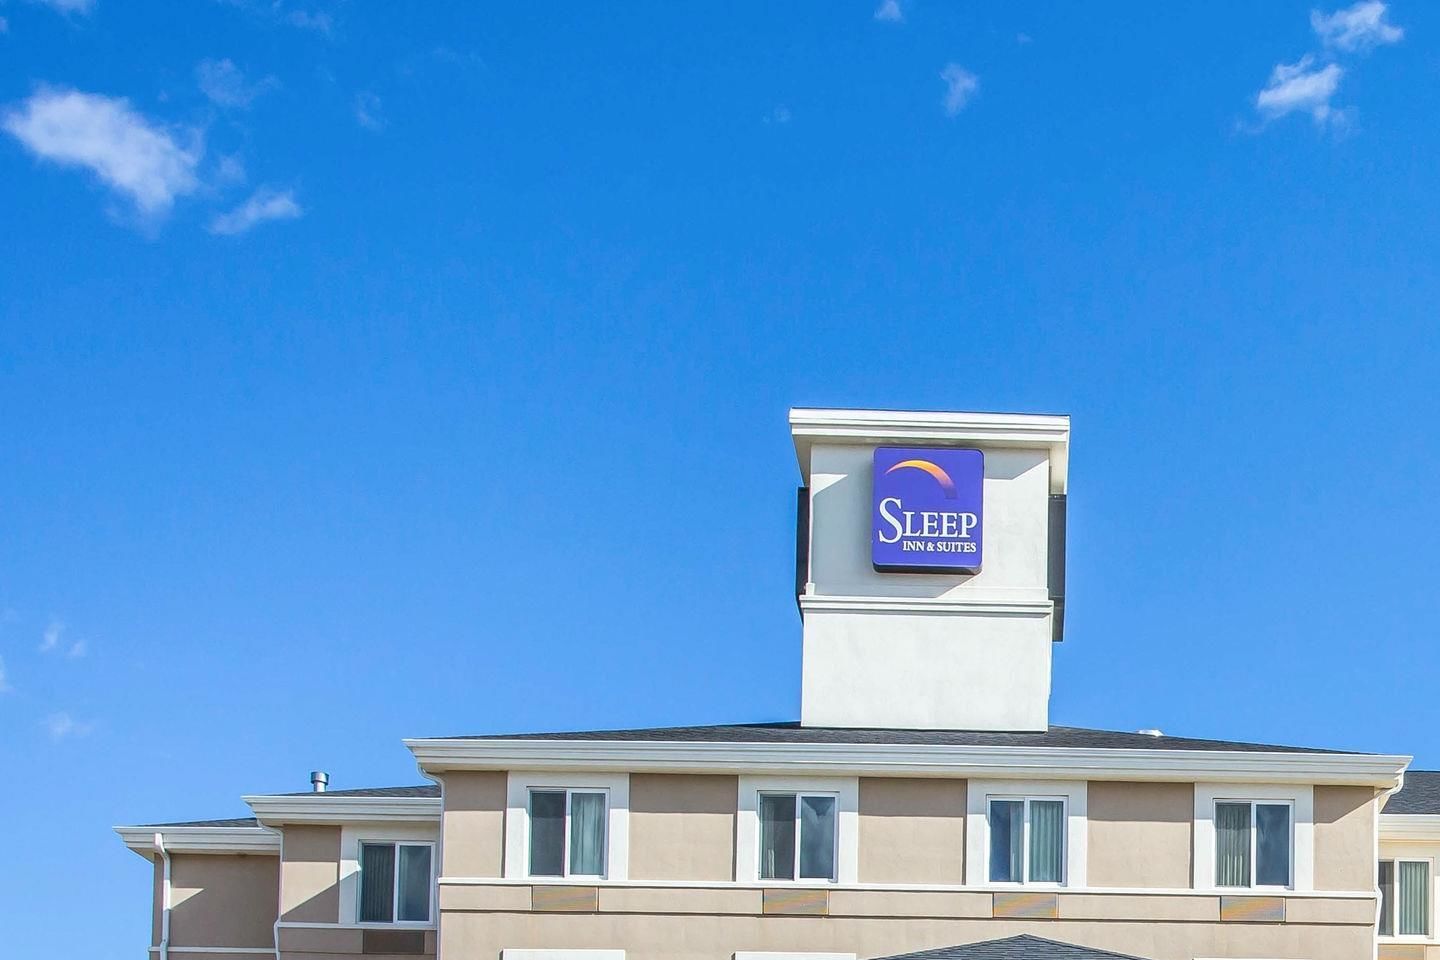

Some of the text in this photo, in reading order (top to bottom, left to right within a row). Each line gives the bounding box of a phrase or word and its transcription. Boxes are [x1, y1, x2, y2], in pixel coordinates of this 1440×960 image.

[879, 497, 978, 544] SLEEP
[903, 541, 977, 553] INN & SUITES
